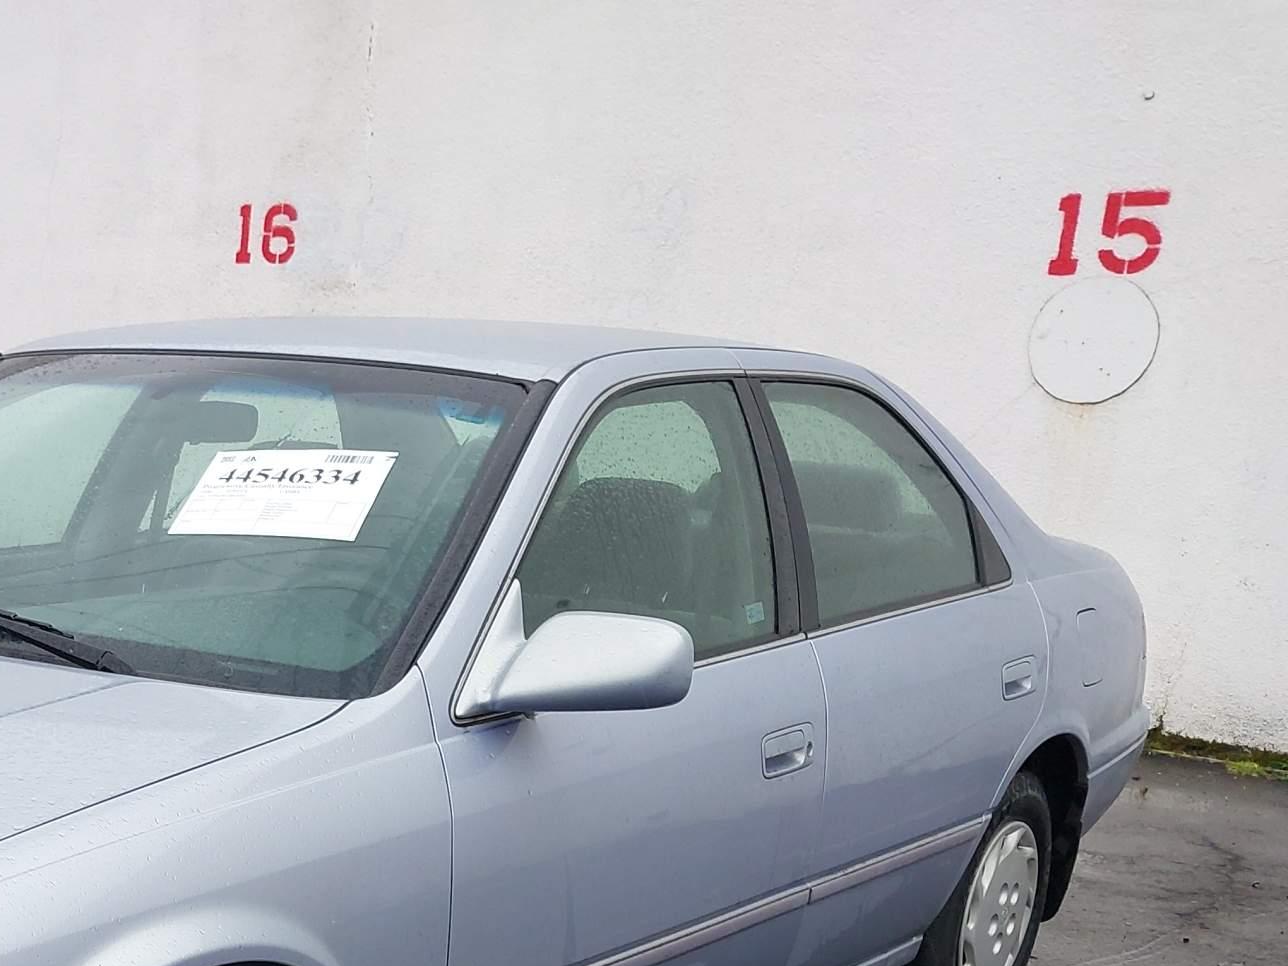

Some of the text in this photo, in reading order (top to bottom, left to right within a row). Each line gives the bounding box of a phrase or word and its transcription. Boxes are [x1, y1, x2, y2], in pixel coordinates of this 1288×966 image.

[234, 202, 297, 266] 16
[1047, 187, 1171, 278] 15
[218, 467, 362, 486] 44546334
